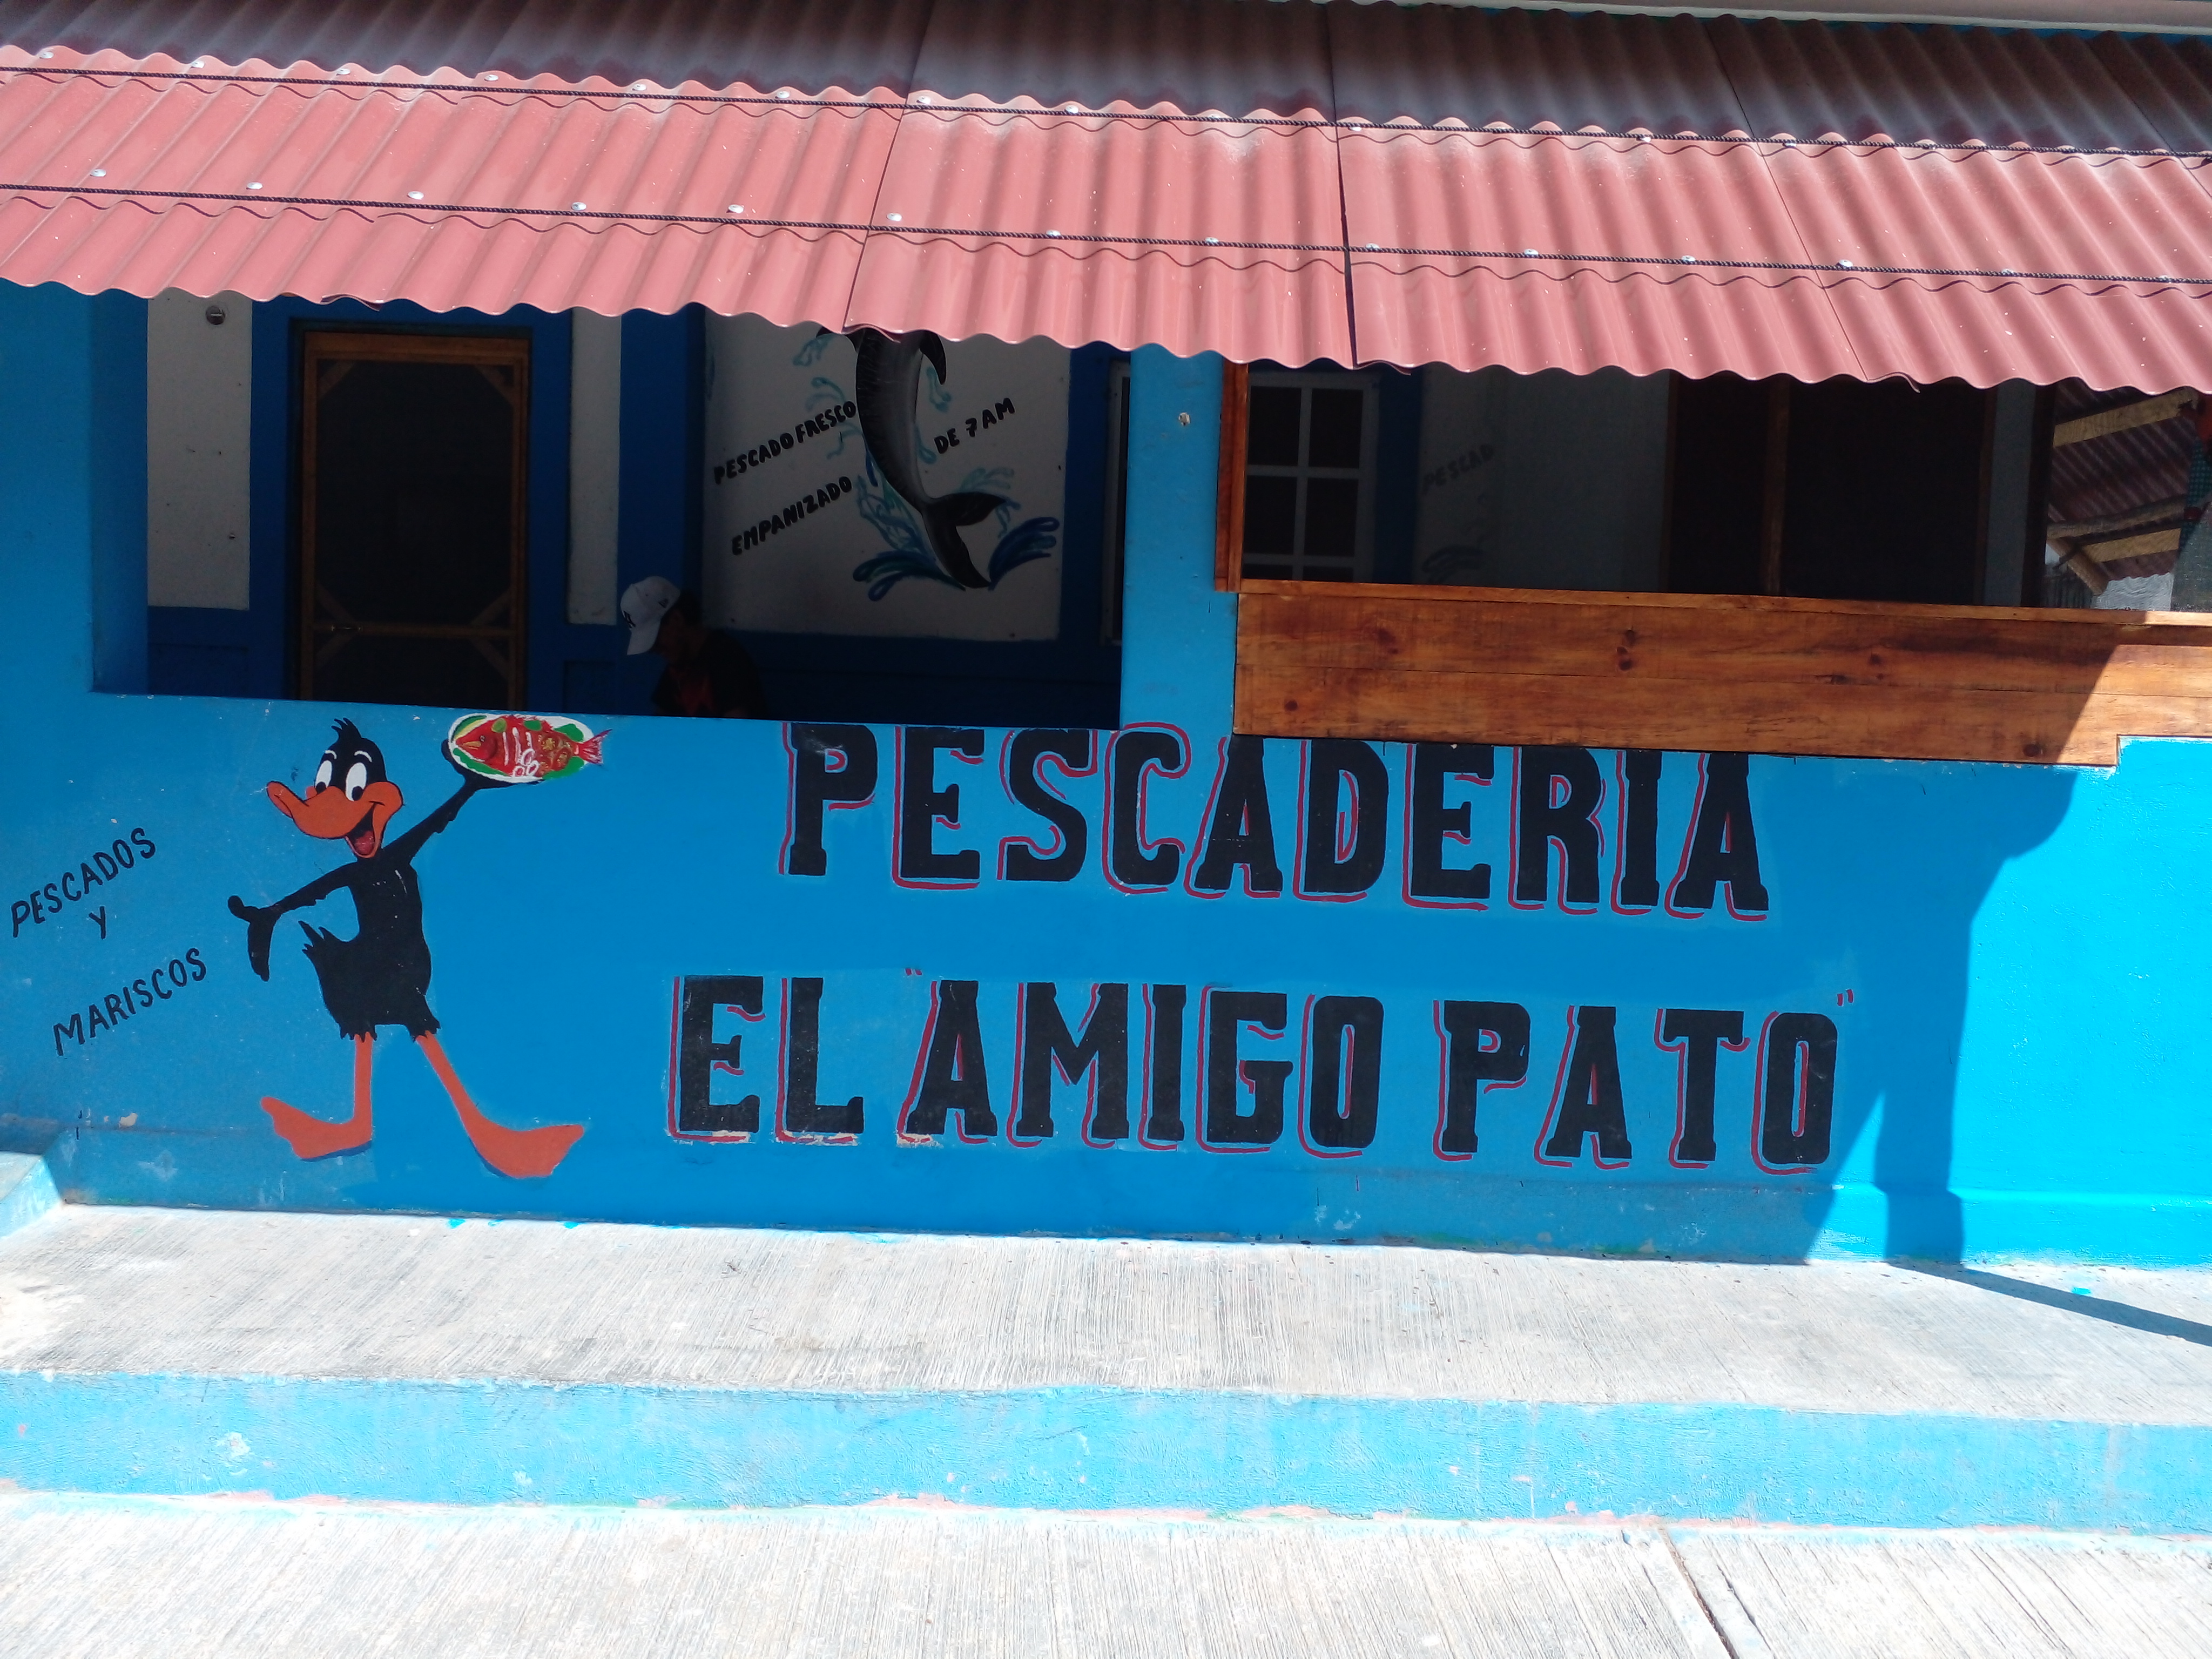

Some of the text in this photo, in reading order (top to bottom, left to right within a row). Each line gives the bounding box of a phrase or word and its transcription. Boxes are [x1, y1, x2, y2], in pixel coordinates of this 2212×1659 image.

[714, 401, 856, 484] PESCADO FRESCO
[934, 428, 960, 454] DE
[982, 397, 1015, 429] AM
[732, 476, 853, 556] EMPANIZADO
[778, 722, 1769, 921] PESCADERIA
[11, 827, 156, 938] PESCADOS
[88, 906, 106, 940] Y
[53, 947, 207, 1056] MARISCOS
[668, 975, 864, 1144] EL
